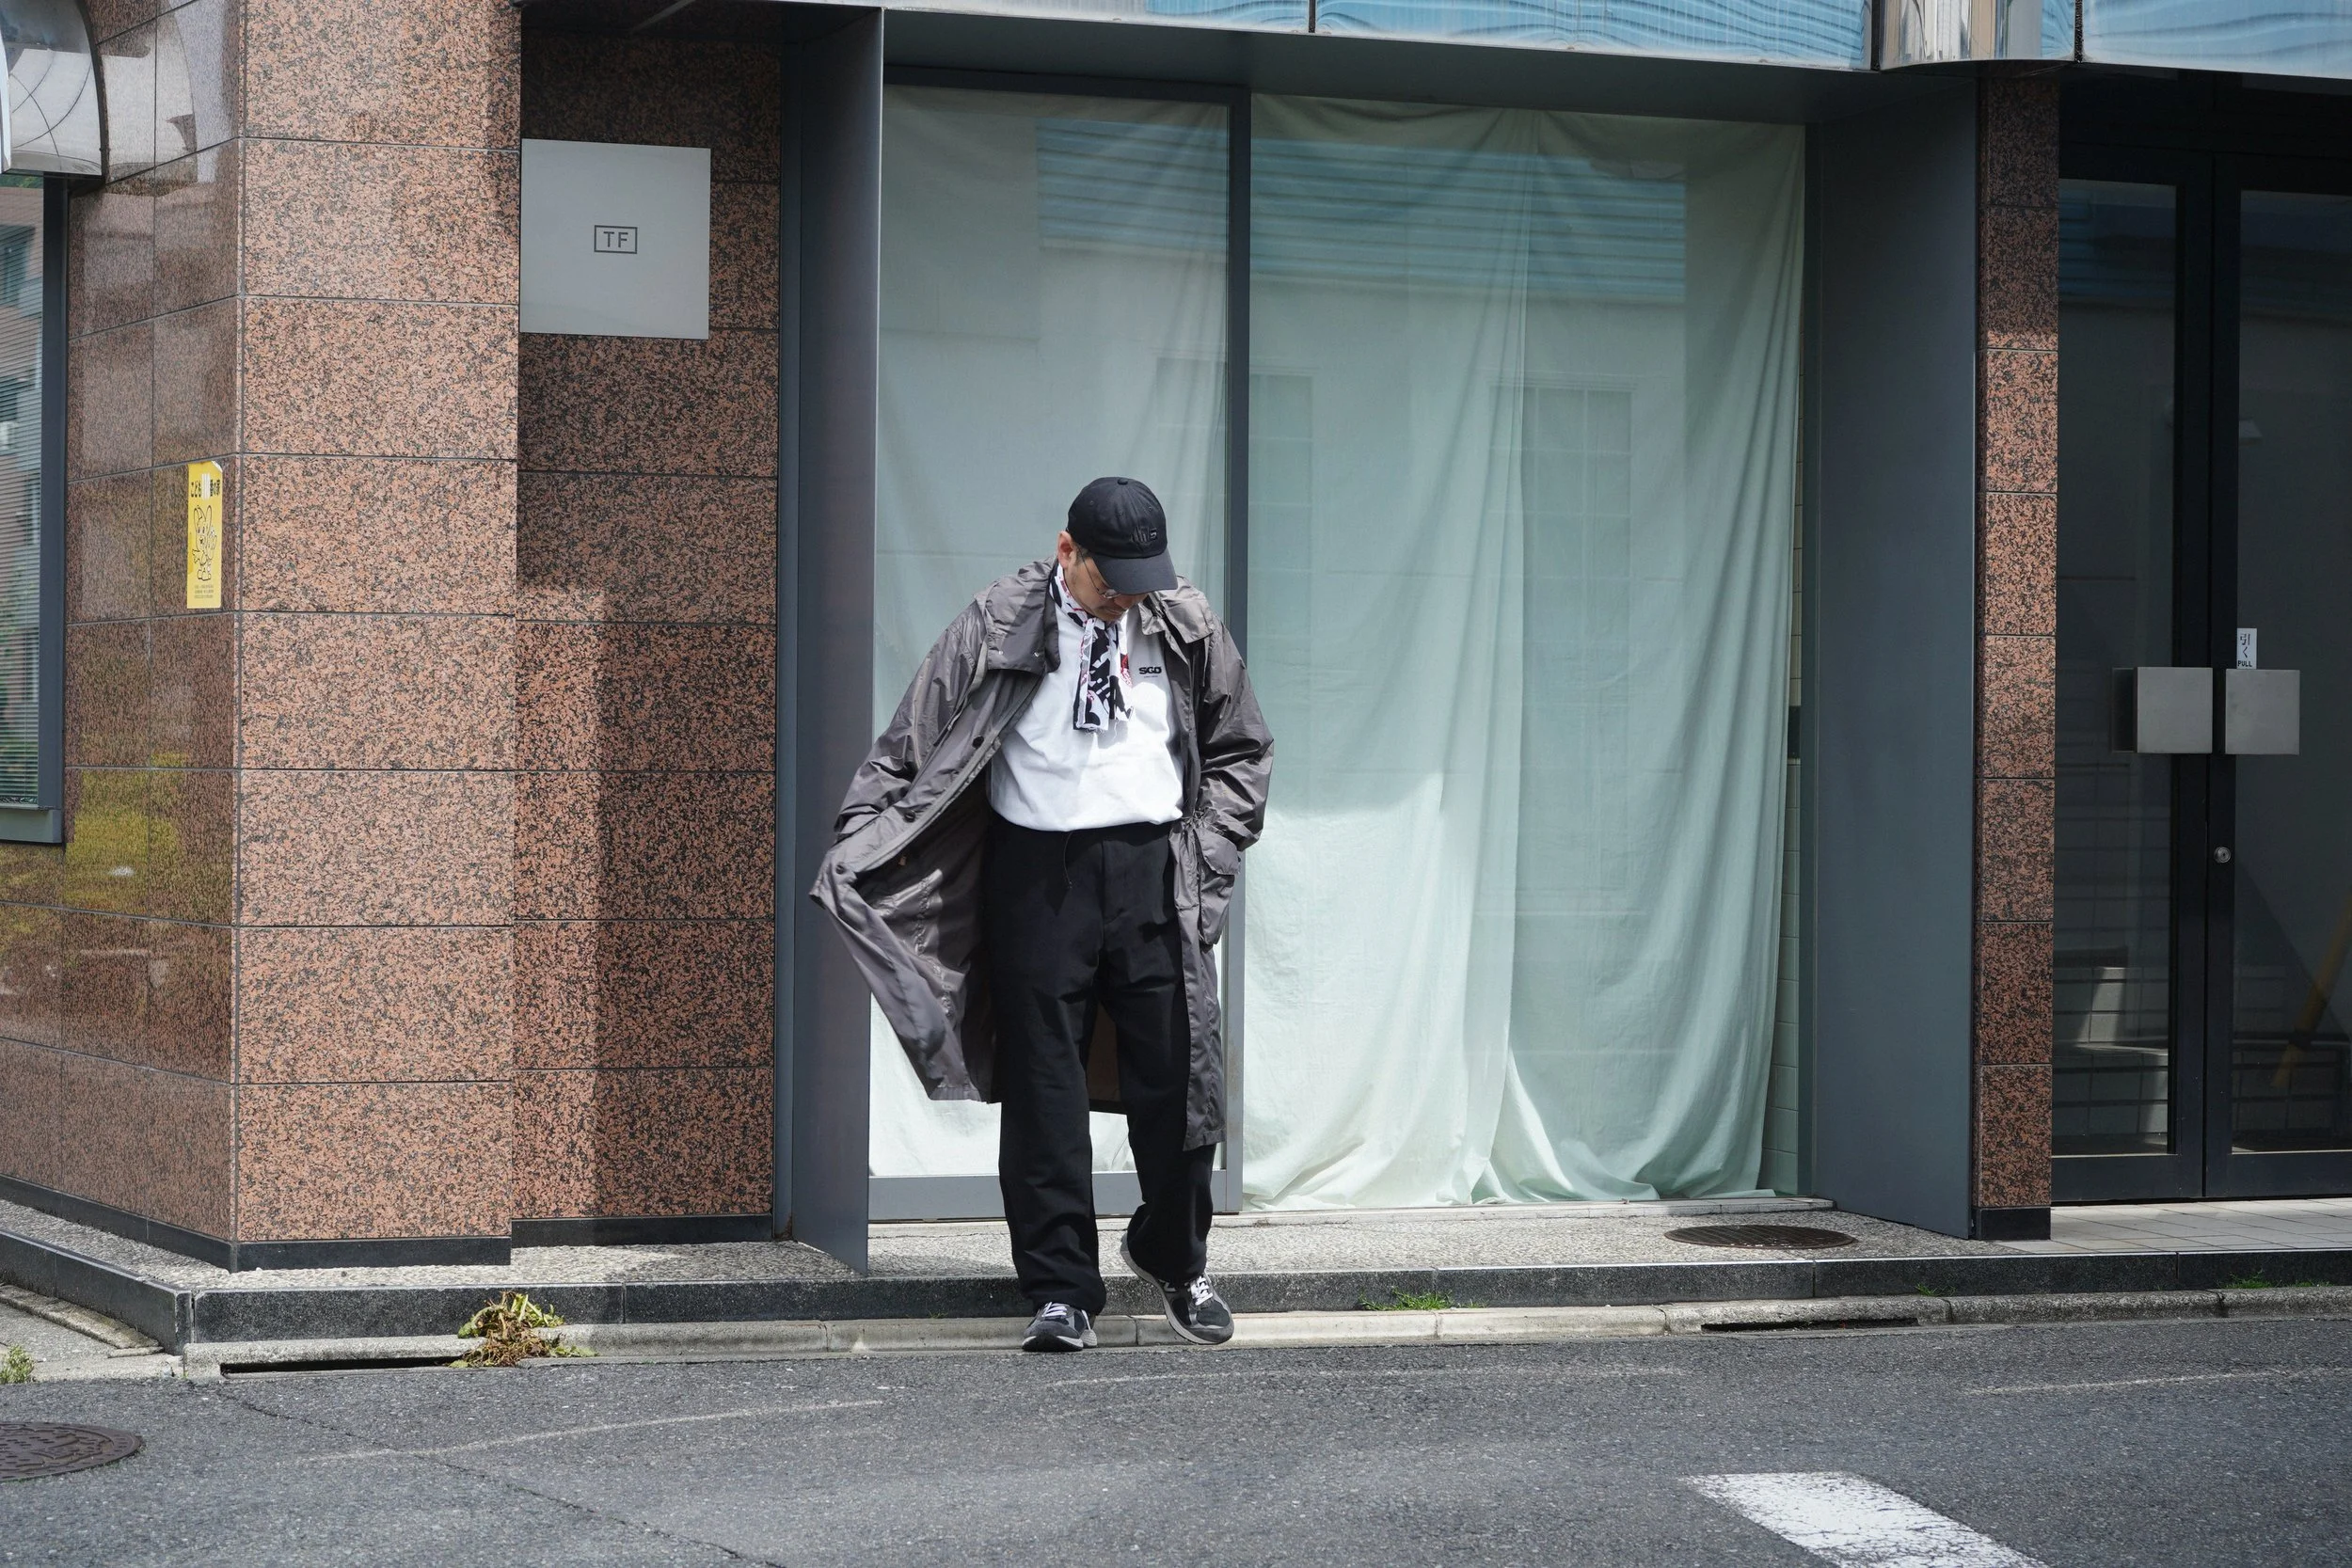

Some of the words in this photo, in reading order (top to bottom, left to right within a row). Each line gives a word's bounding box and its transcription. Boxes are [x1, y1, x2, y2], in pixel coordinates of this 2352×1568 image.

[603, 231, 628, 247] TF
[2240, 633, 2250, 658] 引く
[2237, 659, 2253, 668] PULL
